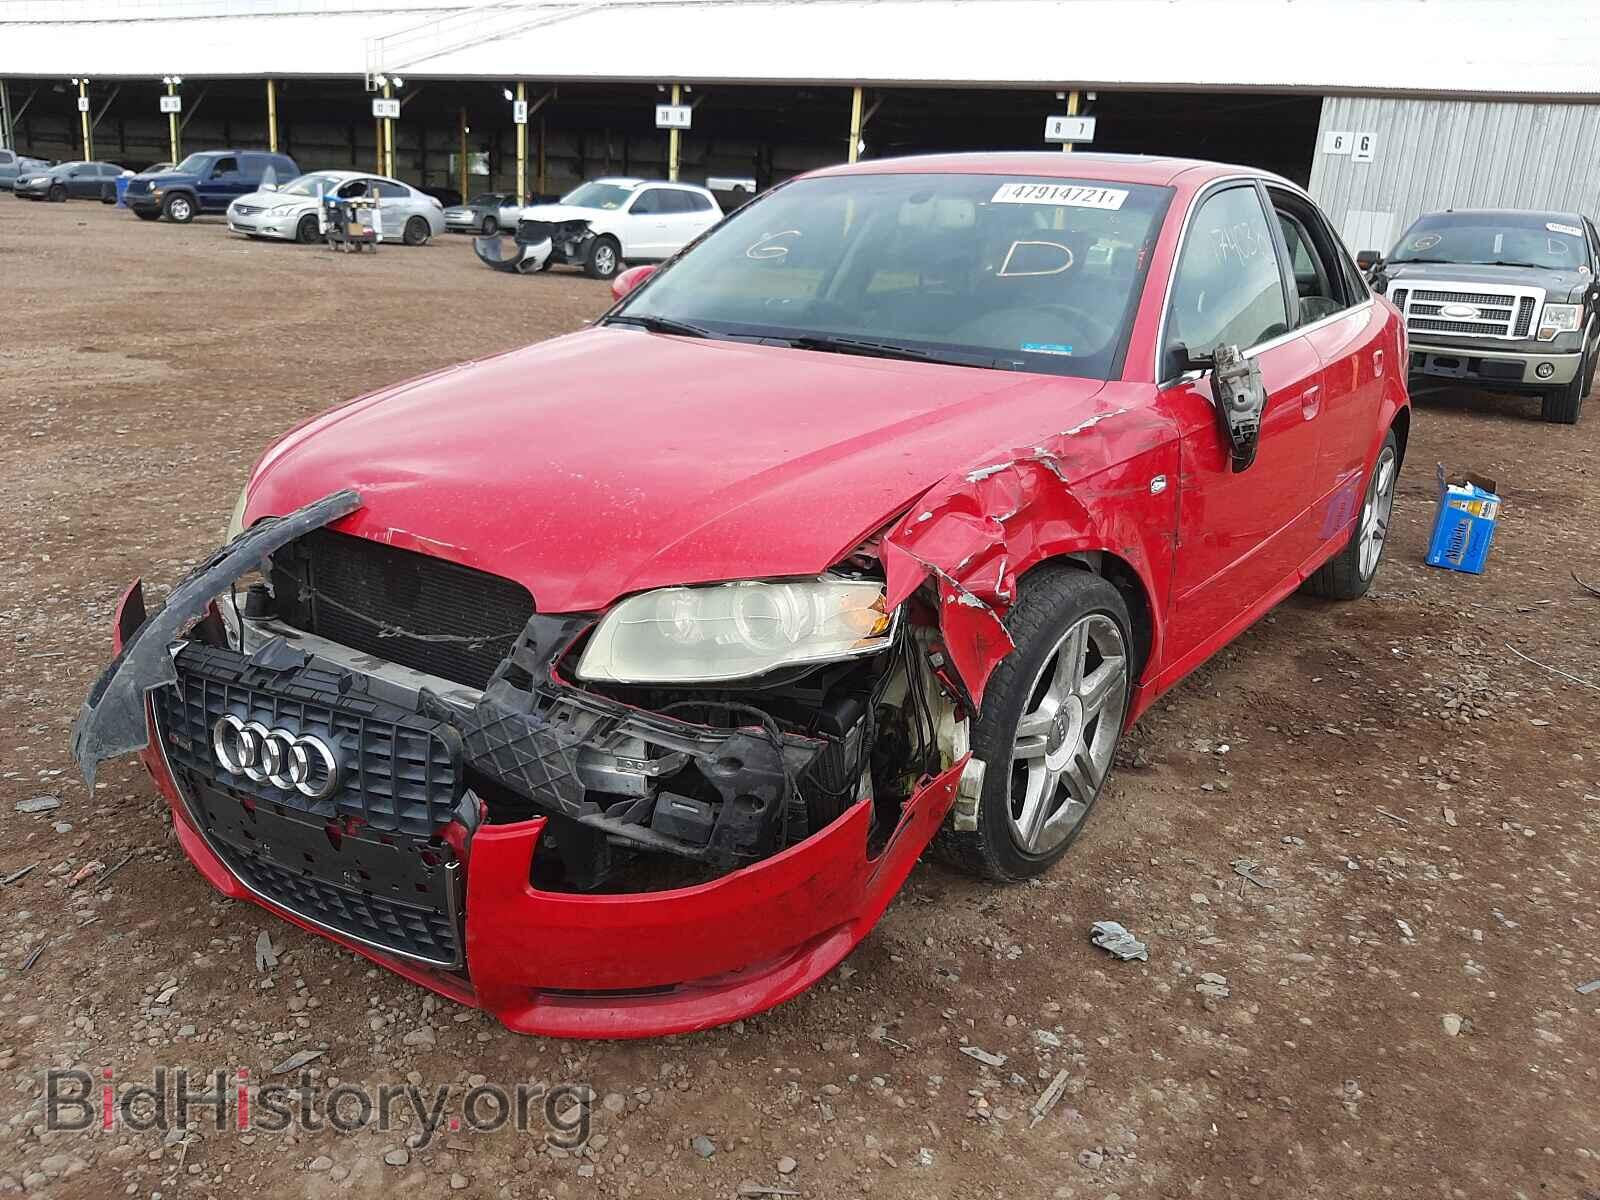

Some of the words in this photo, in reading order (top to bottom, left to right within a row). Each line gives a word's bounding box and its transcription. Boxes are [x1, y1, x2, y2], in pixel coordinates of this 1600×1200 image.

[1055, 121, 1062, 135] 8
[1079, 122, 1085, 135] 7
[1334, 135, 1343, 150] 6
[1360, 136, 1370, 151] G
[995, 240, 1074, 277] D
